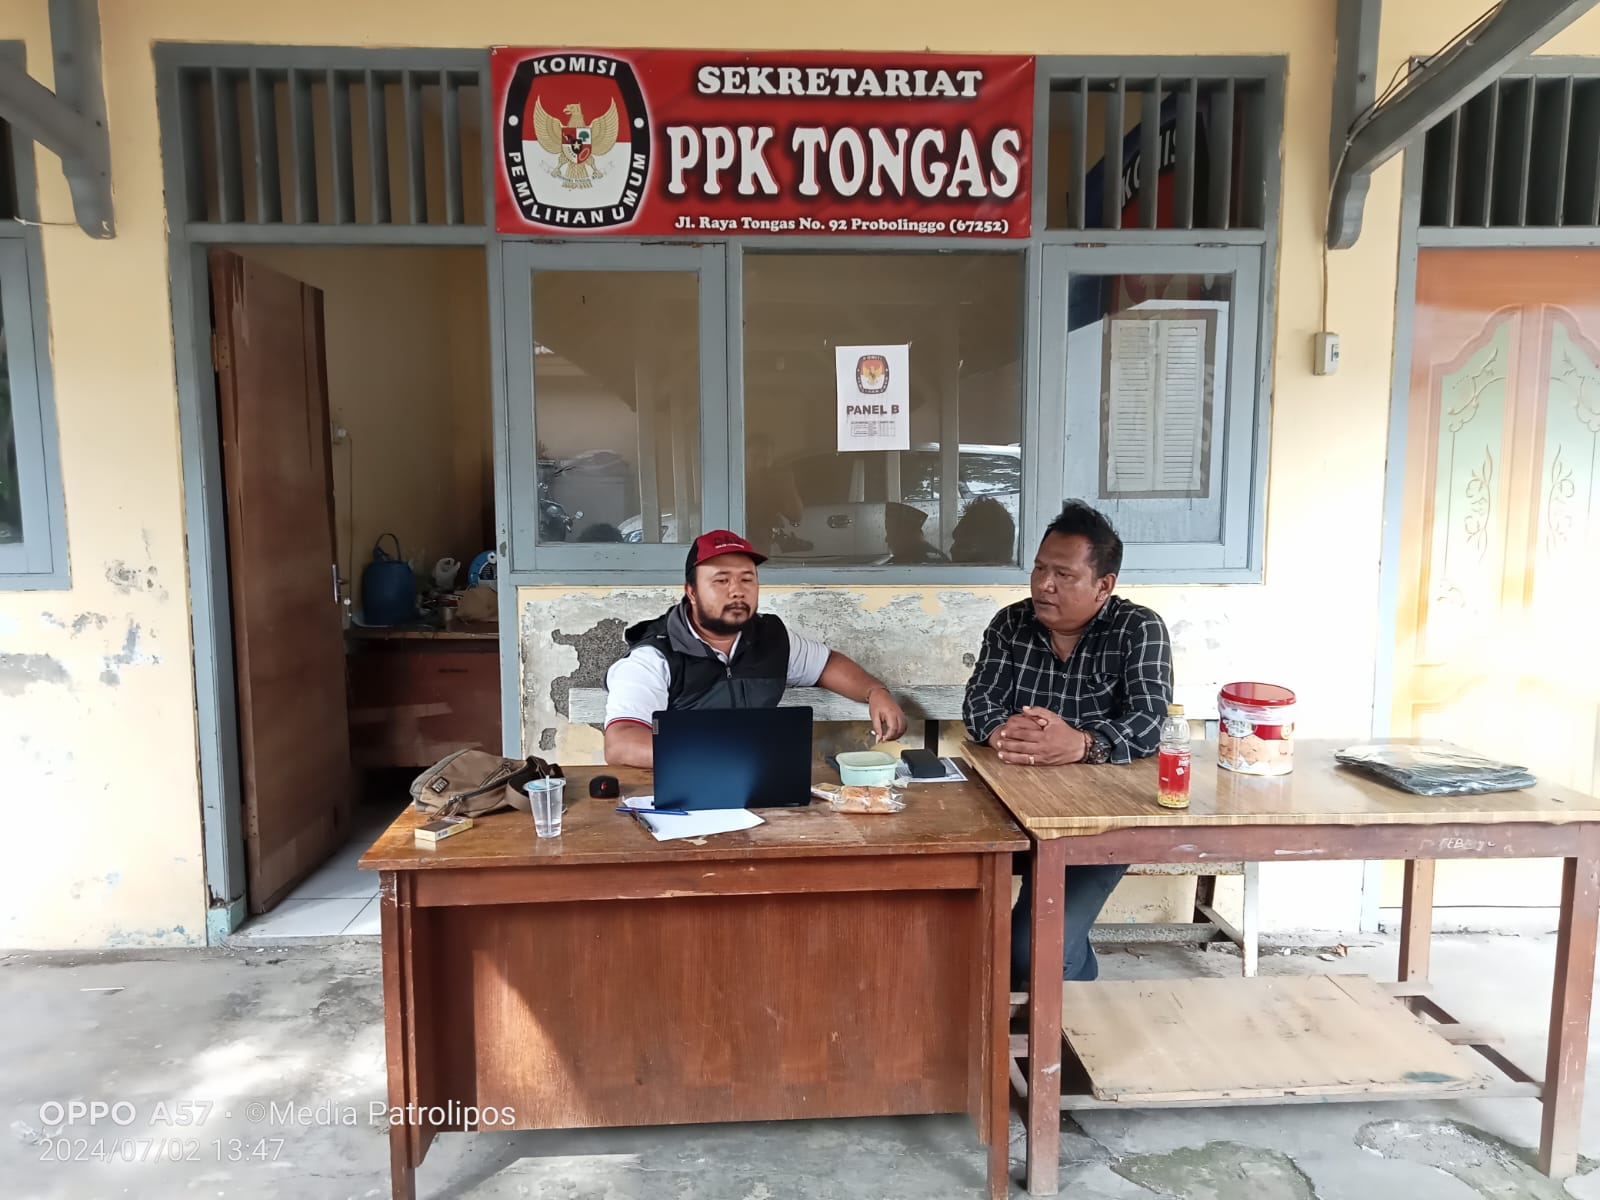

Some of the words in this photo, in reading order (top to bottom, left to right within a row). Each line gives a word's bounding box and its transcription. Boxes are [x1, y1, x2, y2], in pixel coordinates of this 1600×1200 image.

[533, 57, 616, 76] KOMISI
[697, 66, 983, 97] SEKRETARIAT
[667, 126, 780, 195] PPK
[792, 127, 1022, 198] TONGAS
[508, 152, 603, 224] PEMILIHAN
[612, 153, 646, 220] UMUM
[675, 216, 695, 229] Jl.
[699, 216, 738, 231] Raya
[741, 217, 795, 232] Tongas
[799, 218, 825, 230] No.
[829, 218, 847, 231] 92
[851, 217, 946, 234] Probolinggo
[950, 219, 1009, 234] (67252)
[846, 405, 887, 415] PANEL
[891, 405, 899, 414] B
